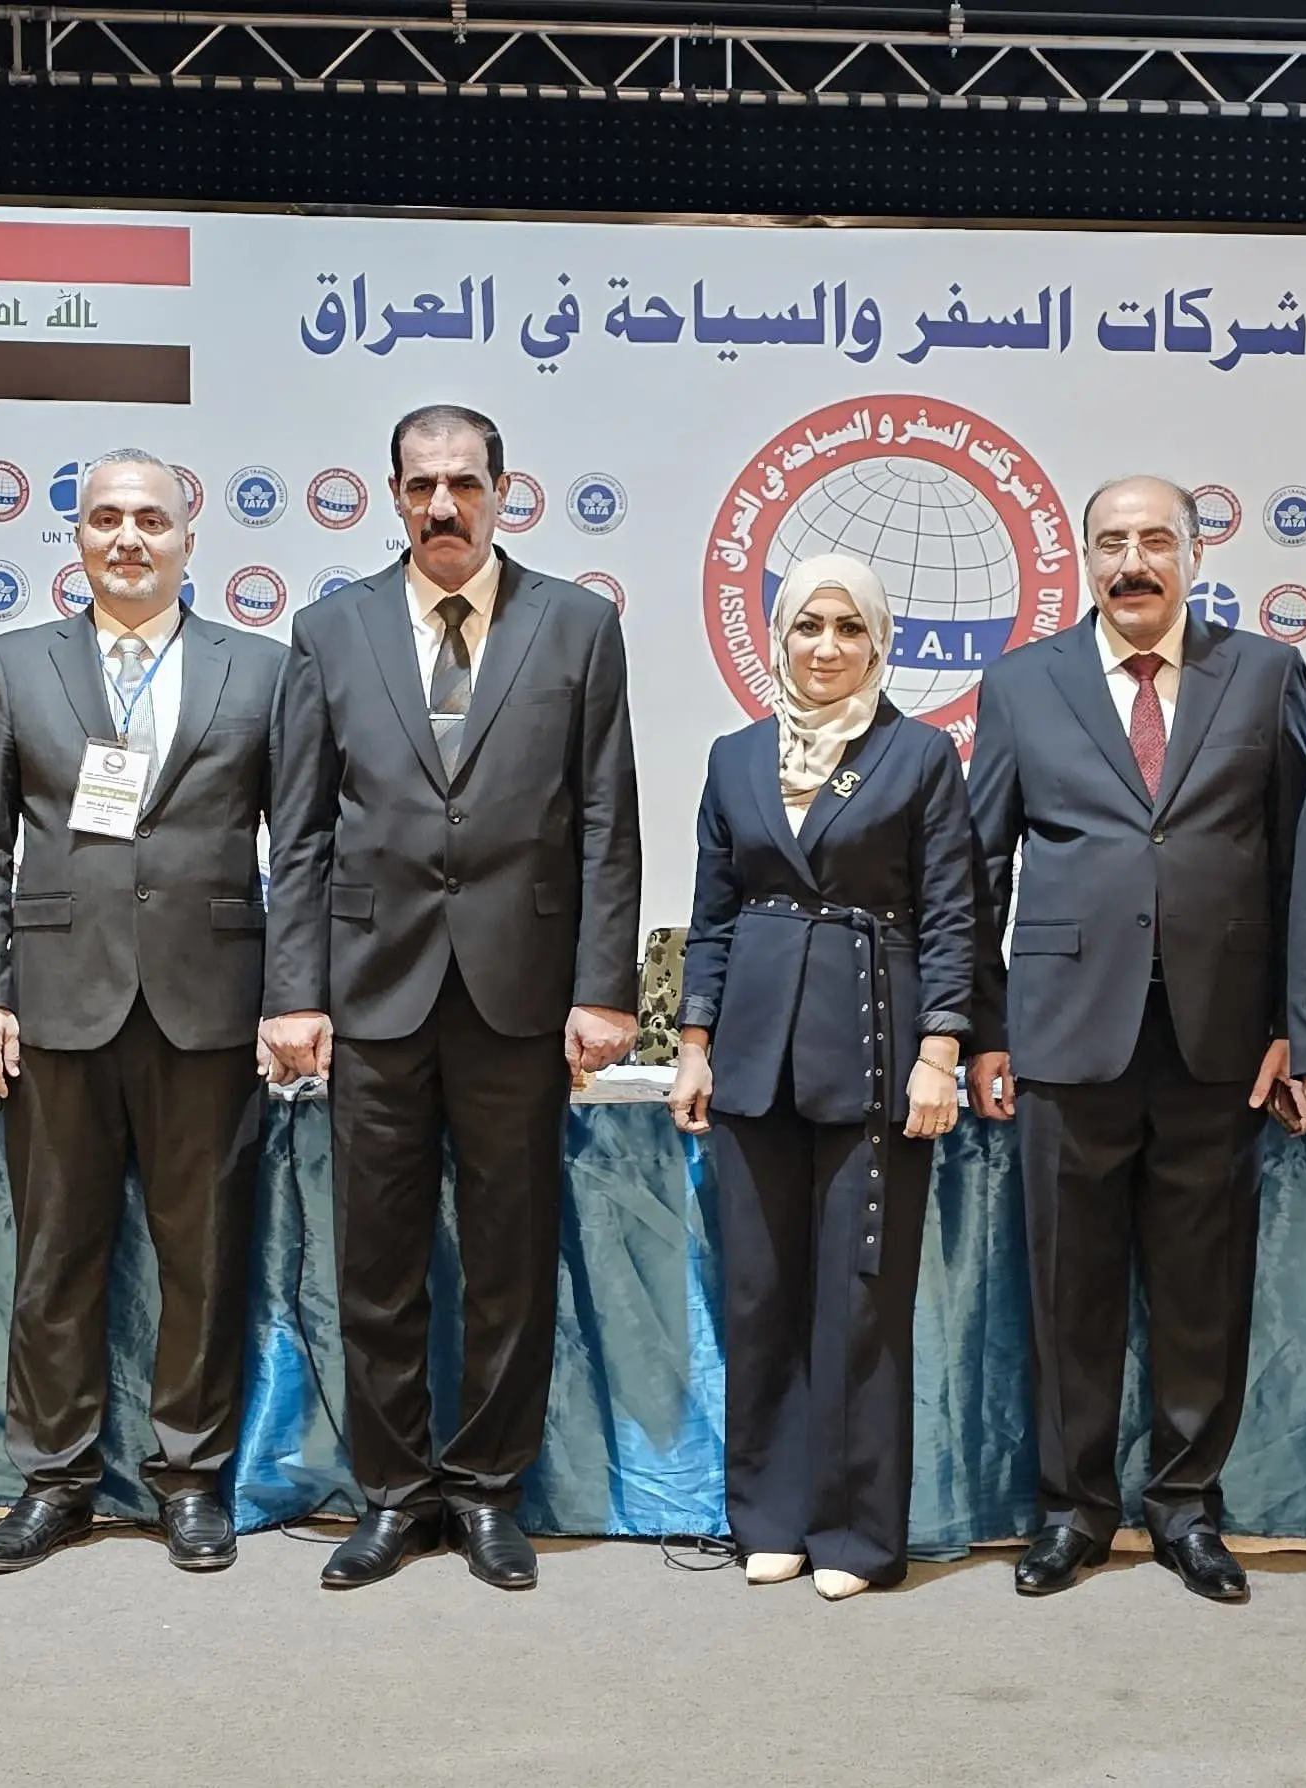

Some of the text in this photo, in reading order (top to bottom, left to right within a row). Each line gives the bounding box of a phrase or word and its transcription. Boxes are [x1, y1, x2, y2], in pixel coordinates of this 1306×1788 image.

[300, 272, 495, 356] العراق
[520, 272, 580, 374] في
[604, 277, 882, 364] والسياحة
[896, 282, 1072, 365] السفر
[1097, 287, 1306, 372] شركات
[773, 408, 872, 472] السياحة
[894, 408, 972, 451] السفر
[243, 499, 270, 508] IATA
[756, 461, 790, 501] في
[967, 438, 1043, 510] شركات
[42, 531, 61, 543] UN
[583, 506, 610, 515] IATA
[711, 487, 764, 573] العراق
[1029, 502, 1071, 574] رابطة
[1280, 518, 1306, 528] IATA
[386, 539, 405, 550] UN
[1031, 587, 1063, 637] IRAQ
